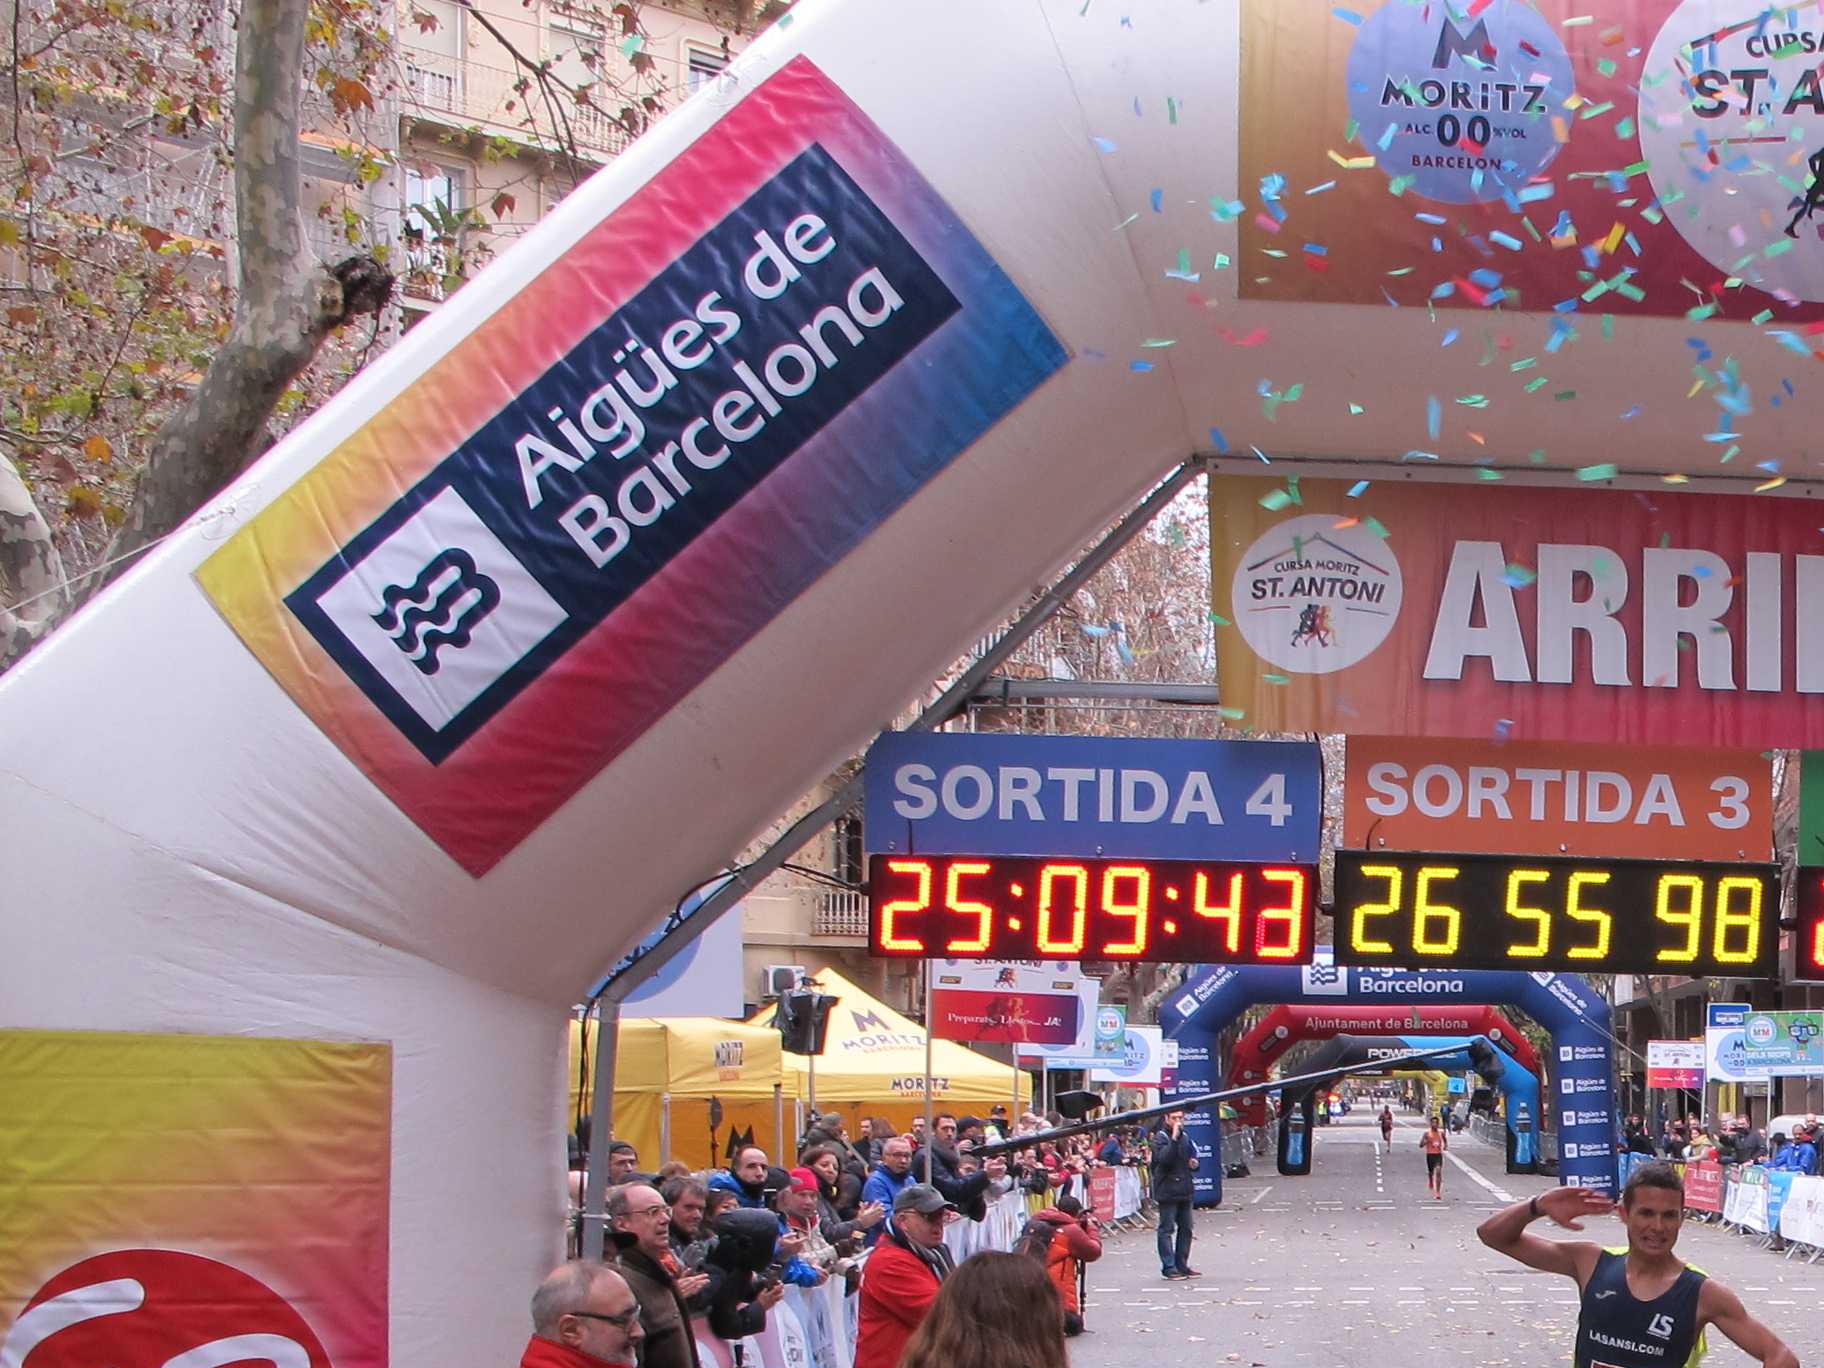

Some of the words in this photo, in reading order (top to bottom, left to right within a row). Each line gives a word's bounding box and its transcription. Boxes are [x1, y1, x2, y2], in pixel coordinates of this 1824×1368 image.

[1380, 74, 1548, 114] MORITZ
[1411, 154, 1507, 171] BARCELON
[514, 290, 742, 513] Aigües
[740, 207, 837, 307] de
[559, 261, 907, 570] Barcelona
[1274, 559, 1312, 574] CURSA
[1315, 560, 1360, 576] MORITZ
[1251, 577, 1284, 600] ST.
[1289, 577, 1386, 604] ANTONI
[891, 762, 1225, 827] SORTIDA
[1245, 773, 1294, 828] 4
[1365, 761, 1685, 827] SORTIDA
[1706, 777, 1752, 830] 3
[1351, 865, 1461, 957] 26
[1506, 869, 1612, 960] 55
[1656, 874, 1762, 964] 98
[1359, 976, 1463, 993] Barcelona
[1305, 1017, 1382, 1031] Ajuntament
[1386, 1017, 1401, 1029] de
[842, 1033, 928, 1051] MORITZ
[1648, 1313, 1675, 1337] LS
[1589, 1330, 1665, 1357] LASANSI.COM
